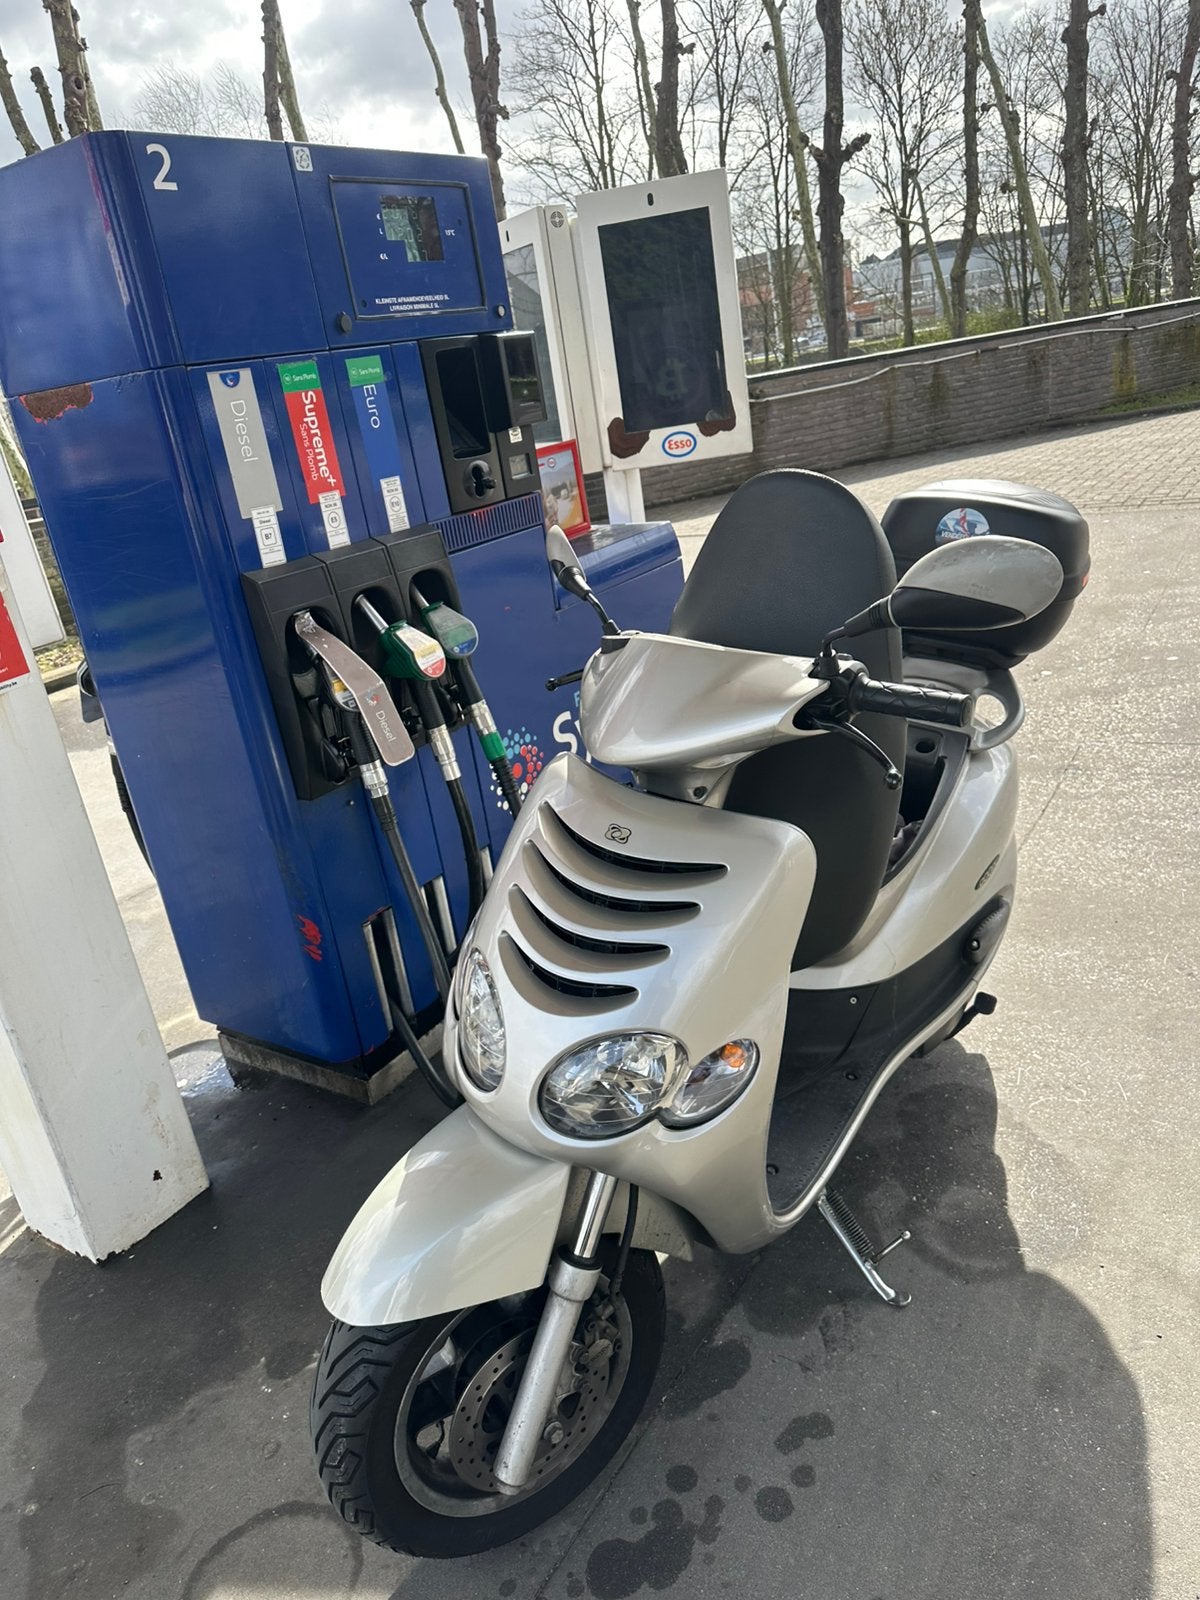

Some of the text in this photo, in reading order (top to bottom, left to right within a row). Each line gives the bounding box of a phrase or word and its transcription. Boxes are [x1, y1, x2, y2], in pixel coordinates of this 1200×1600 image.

[146, 143, 178, 191] 2
[230, 400, 258, 462] Diesel
[363, 384, 381, 428] Euro
[299, 423, 317, 481] Sans Plomb
[301, 391, 337, 487] Supreme+
[376, 710, 397, 742] Diesel
